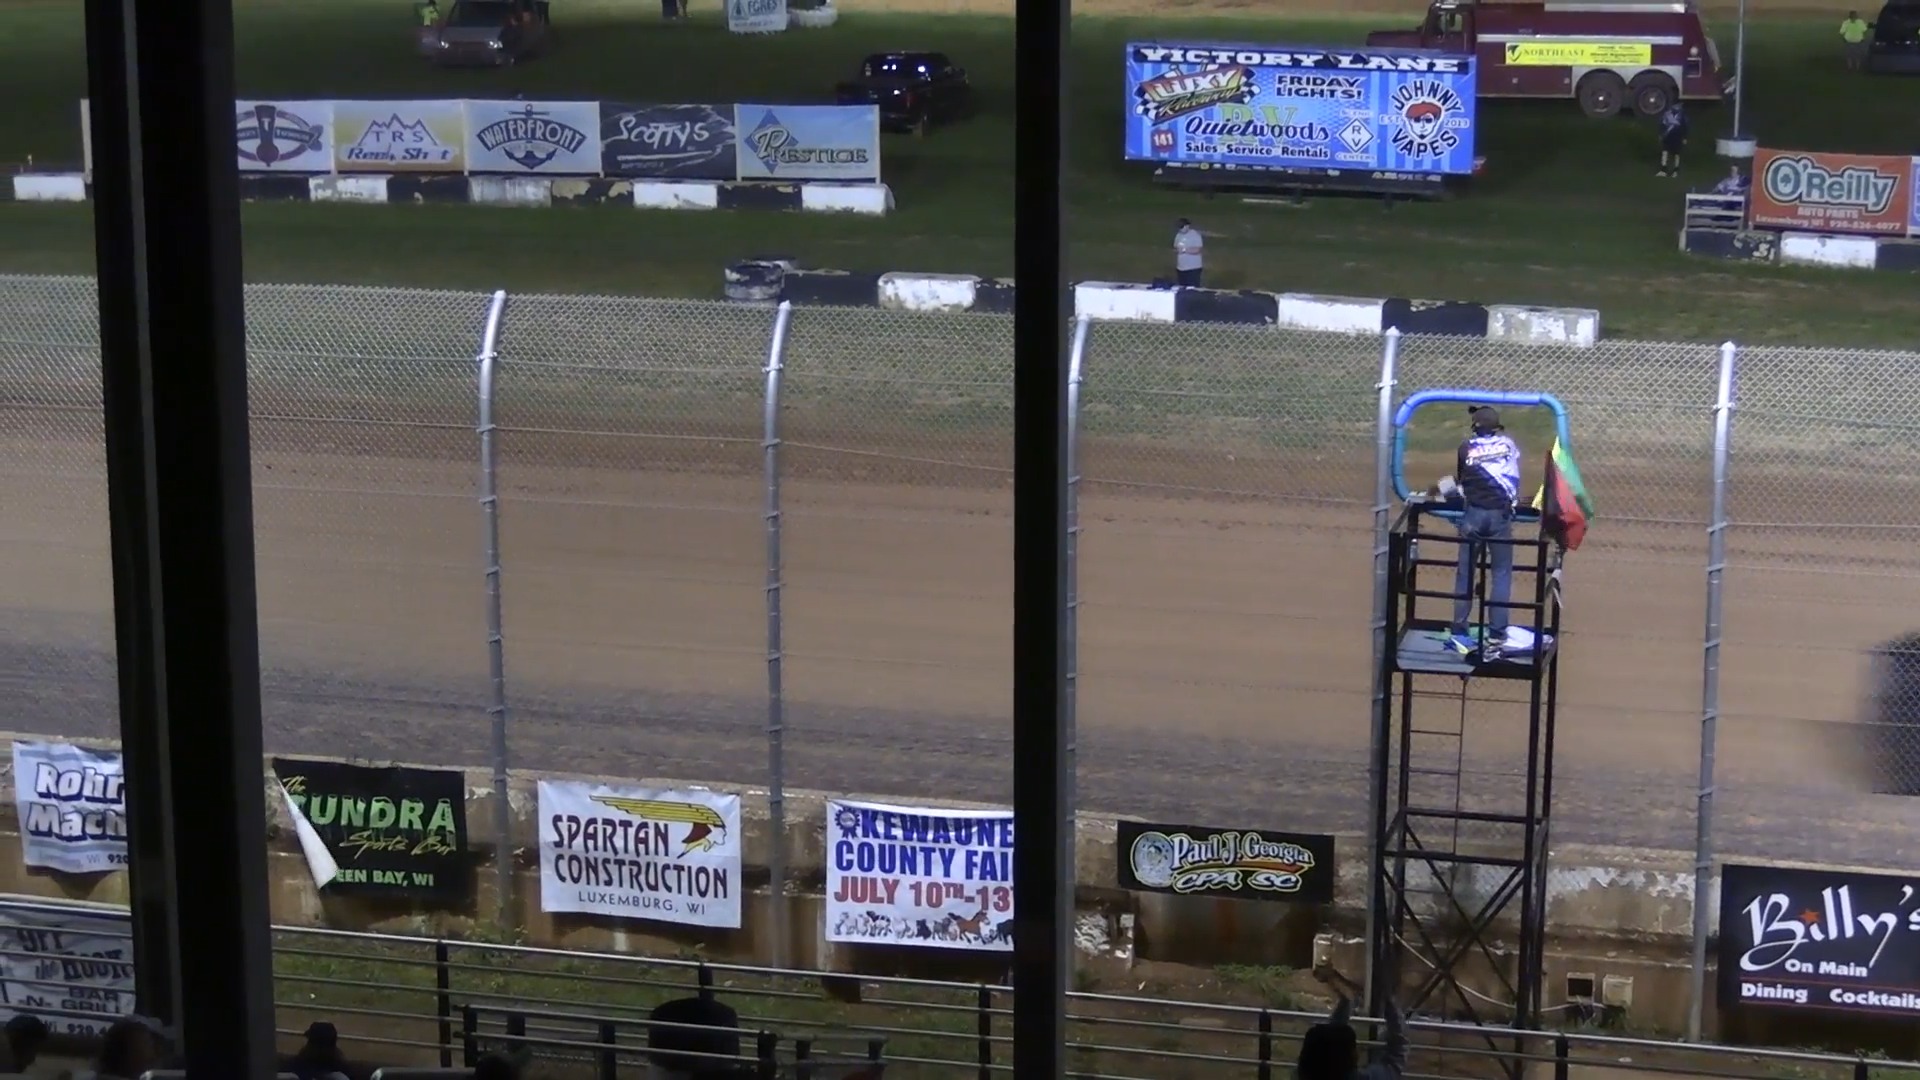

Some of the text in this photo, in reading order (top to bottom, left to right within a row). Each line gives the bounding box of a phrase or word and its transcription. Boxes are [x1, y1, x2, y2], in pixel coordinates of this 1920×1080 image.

[1139, 48, 1459, 72] VICTORY LANE
[1523, 48, 1585, 57] NORTHEAST
[1276, 87, 1363, 99] LIGHTS!
[1277, 75, 1363, 87] FRIDAY
[1391, 79, 1463, 113] JOHNNY
[481, 117, 583, 150] WATERFRONT
[1185, 116, 1329, 142] Quietwoods
[1392, 128, 1458, 158] VAPES
[1185, 142, 1329, 159] Sales Service Rentals
[1767, 160, 1892, 208] O'Reilly
[552, 814, 669, 857] SPARTAN
[835, 840, 956, 878] COUNTY
[1170, 833, 1220, 869] Paul
[1244, 832, 1313, 864] Georgia
[334, 868, 435, 887] EEN BAY, WI
[554, 853, 728, 899] CONSTRUCTION
[1175, 871, 1300, 889] CPA SC
[578, 891, 706, 915] LUXEMBURG, WI
[833, 876, 900, 905] JULY
[1739, 883, 1920, 971] Billy's
[1784, 958, 1868, 978] On Main
[1741, 982, 1920, 1010] Dining Cocktails
